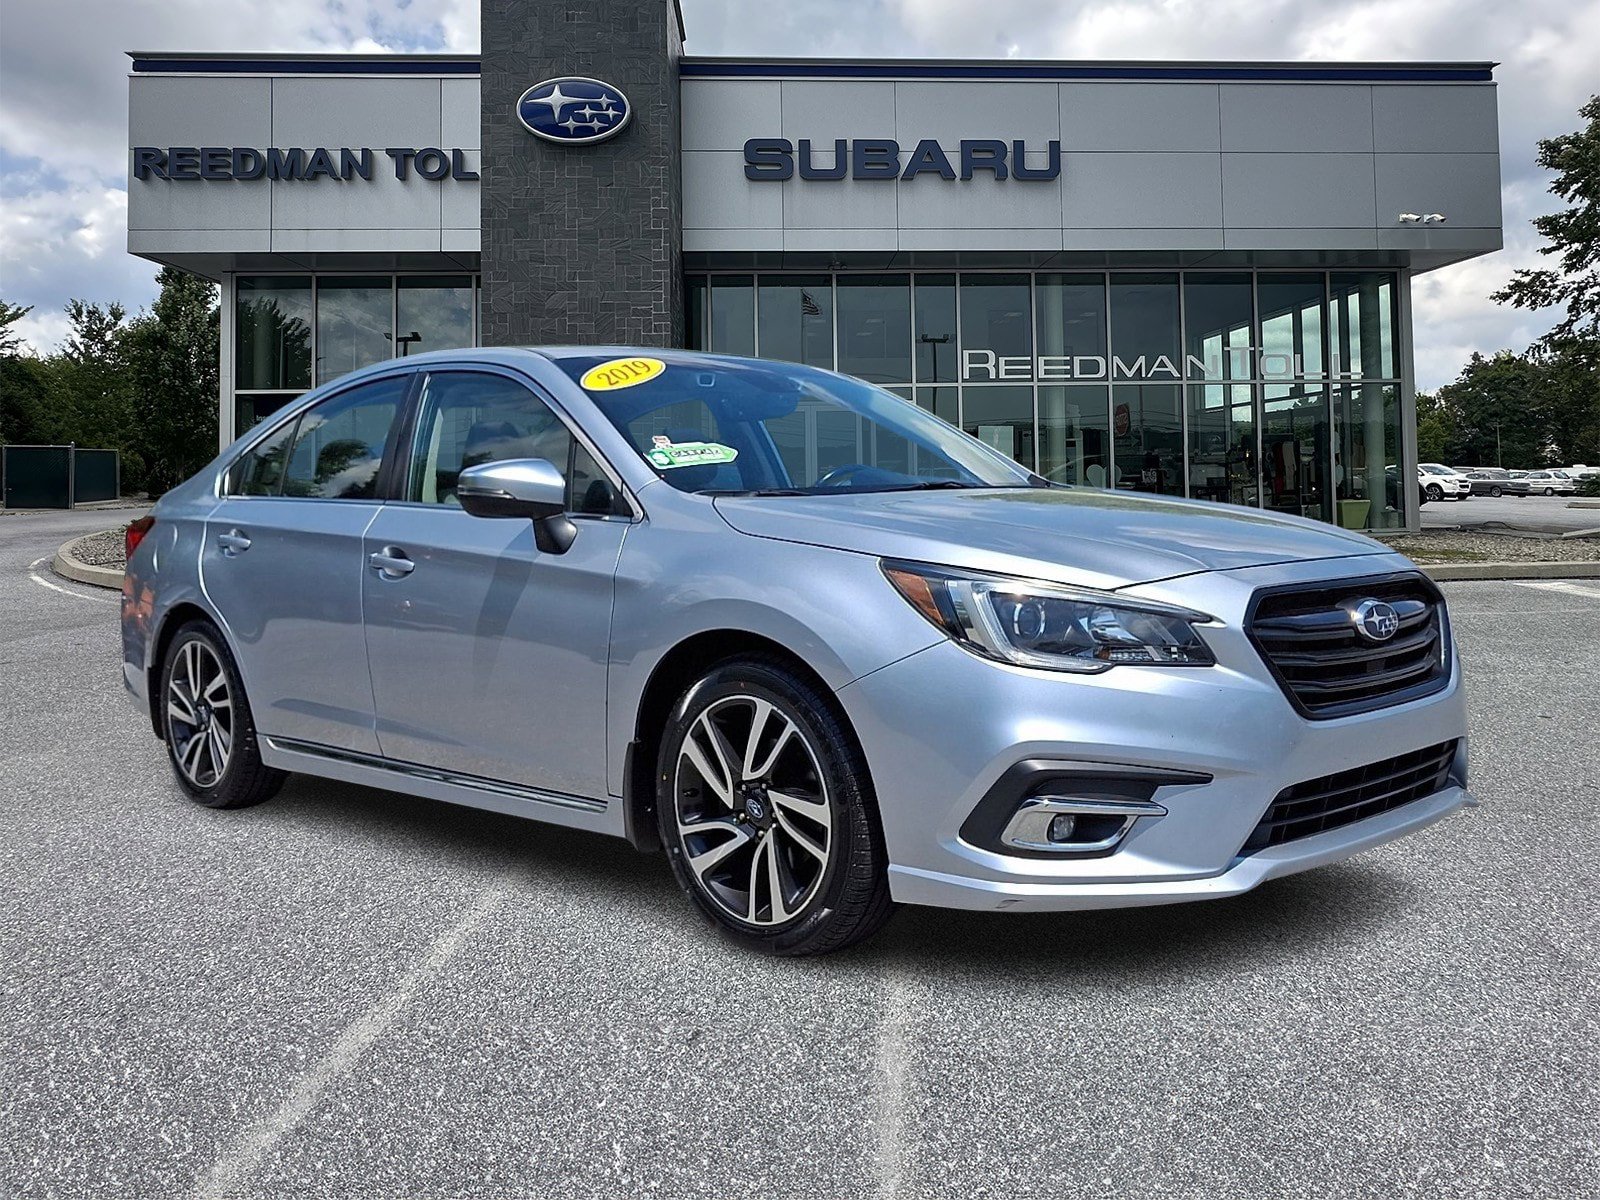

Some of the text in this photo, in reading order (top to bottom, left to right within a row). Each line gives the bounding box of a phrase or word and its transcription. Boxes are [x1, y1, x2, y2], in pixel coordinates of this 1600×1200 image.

[133, 147, 480, 181] REEDMAN TOL
[743, 138, 1062, 181] SUBARU
[597, 360, 651, 386] 2019
[962, 346, 1364, 379] REEDMAN TOLL
